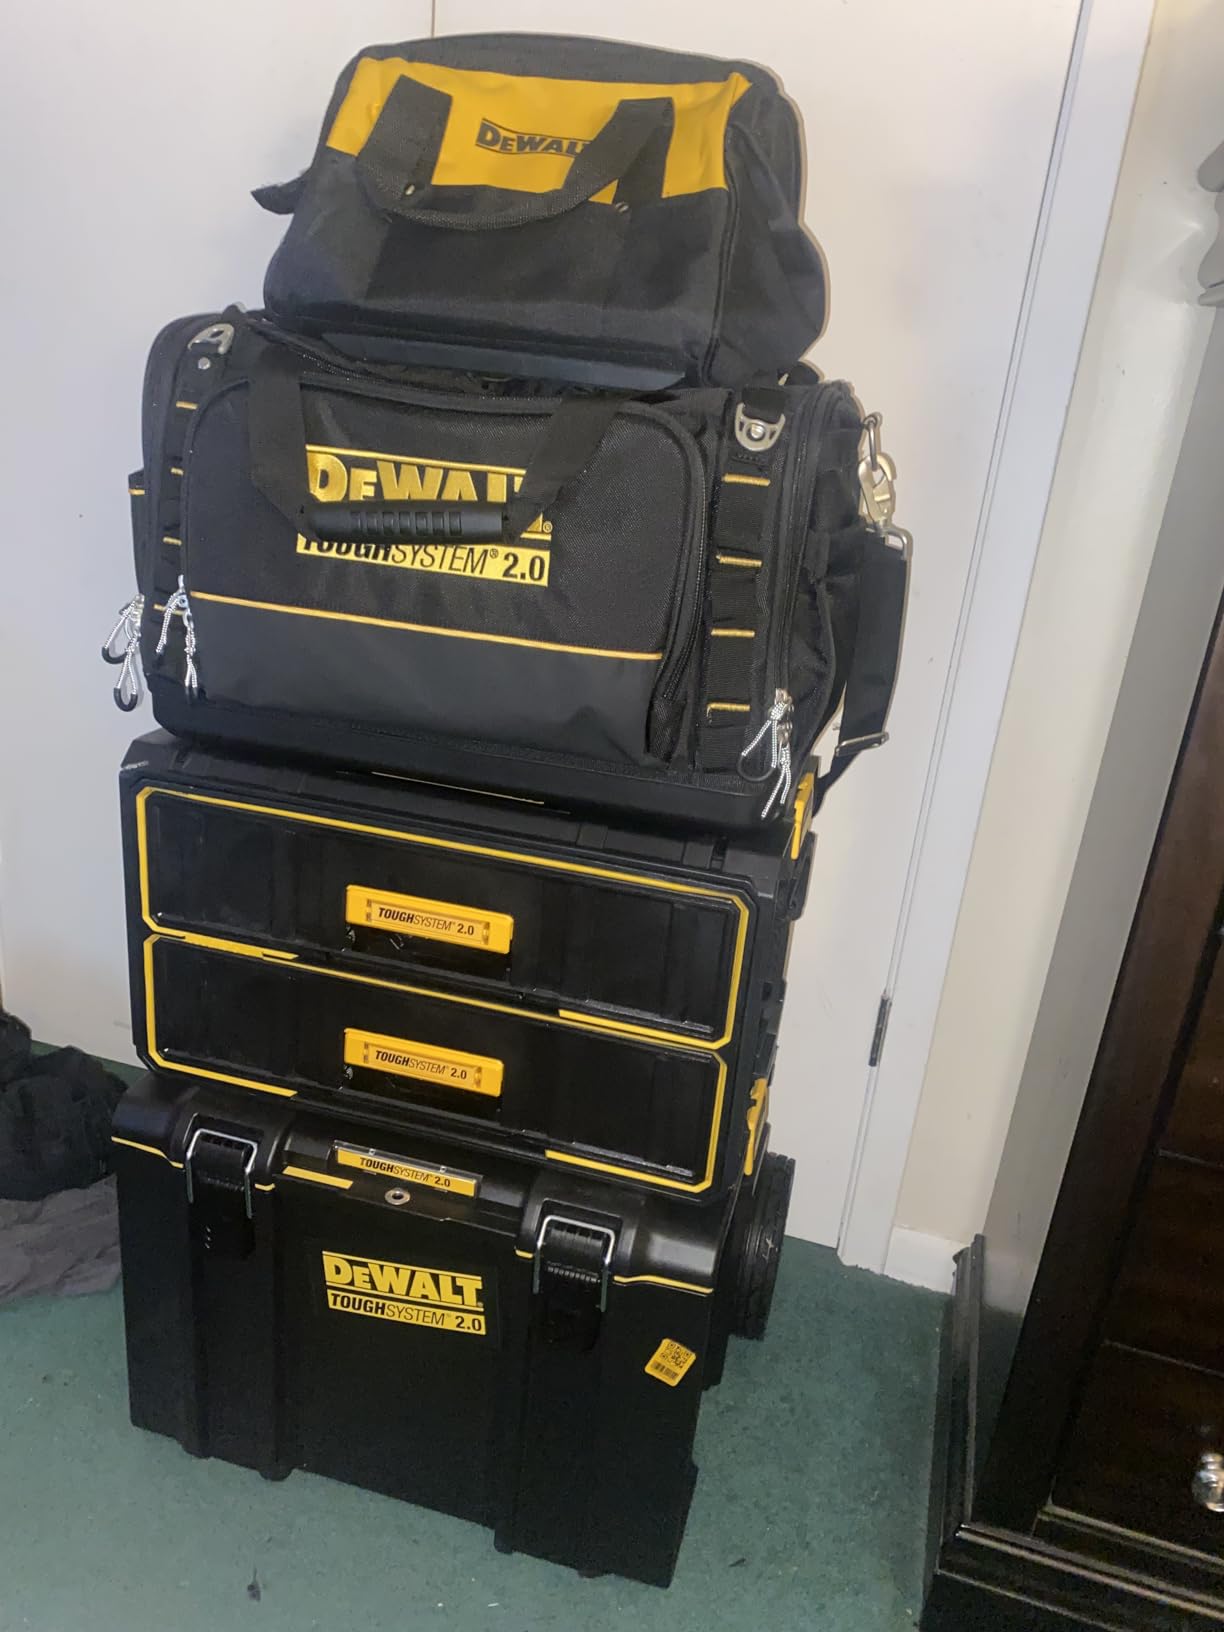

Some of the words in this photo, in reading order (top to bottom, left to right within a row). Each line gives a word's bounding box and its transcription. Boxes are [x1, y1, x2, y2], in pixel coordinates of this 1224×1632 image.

[477, 121, 588, 156] DEWAL
[502, 552, 546, 581] 2.0
[457, 923, 474, 936] 2.0
[451, 1067, 467, 1080] 2.0
[435, 1176, 451, 1188] 2.0
[455, 1315, 482, 1331] 2.0
